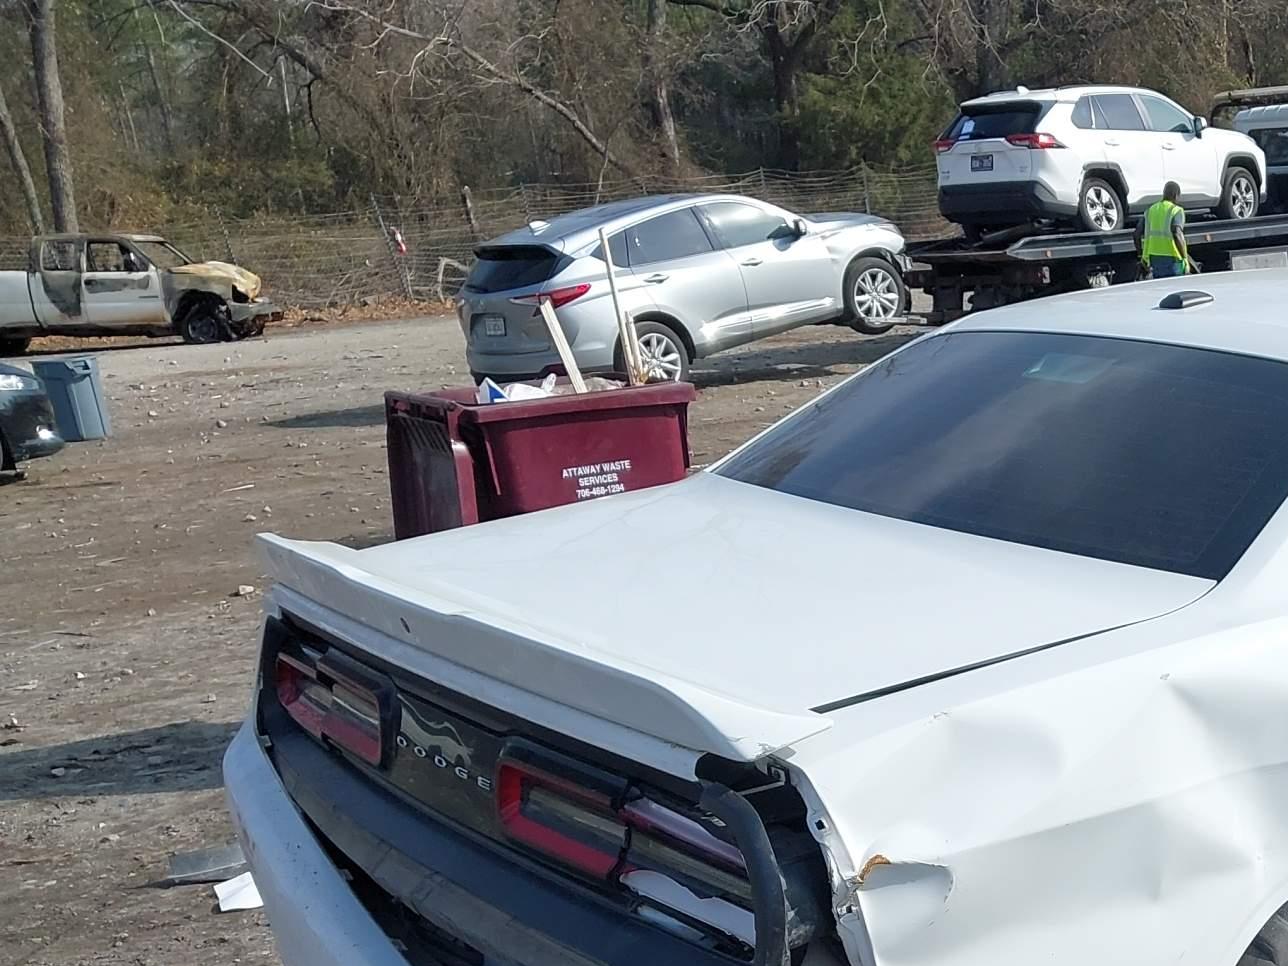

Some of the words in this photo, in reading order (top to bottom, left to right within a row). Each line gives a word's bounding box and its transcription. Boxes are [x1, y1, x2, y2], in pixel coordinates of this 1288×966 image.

[562, 464, 601, 479] ATTAWAY
[601, 460, 632, 472] WASTE
[578, 473, 619, 487] SERVICES
[396, 735, 492, 792] DODGE
